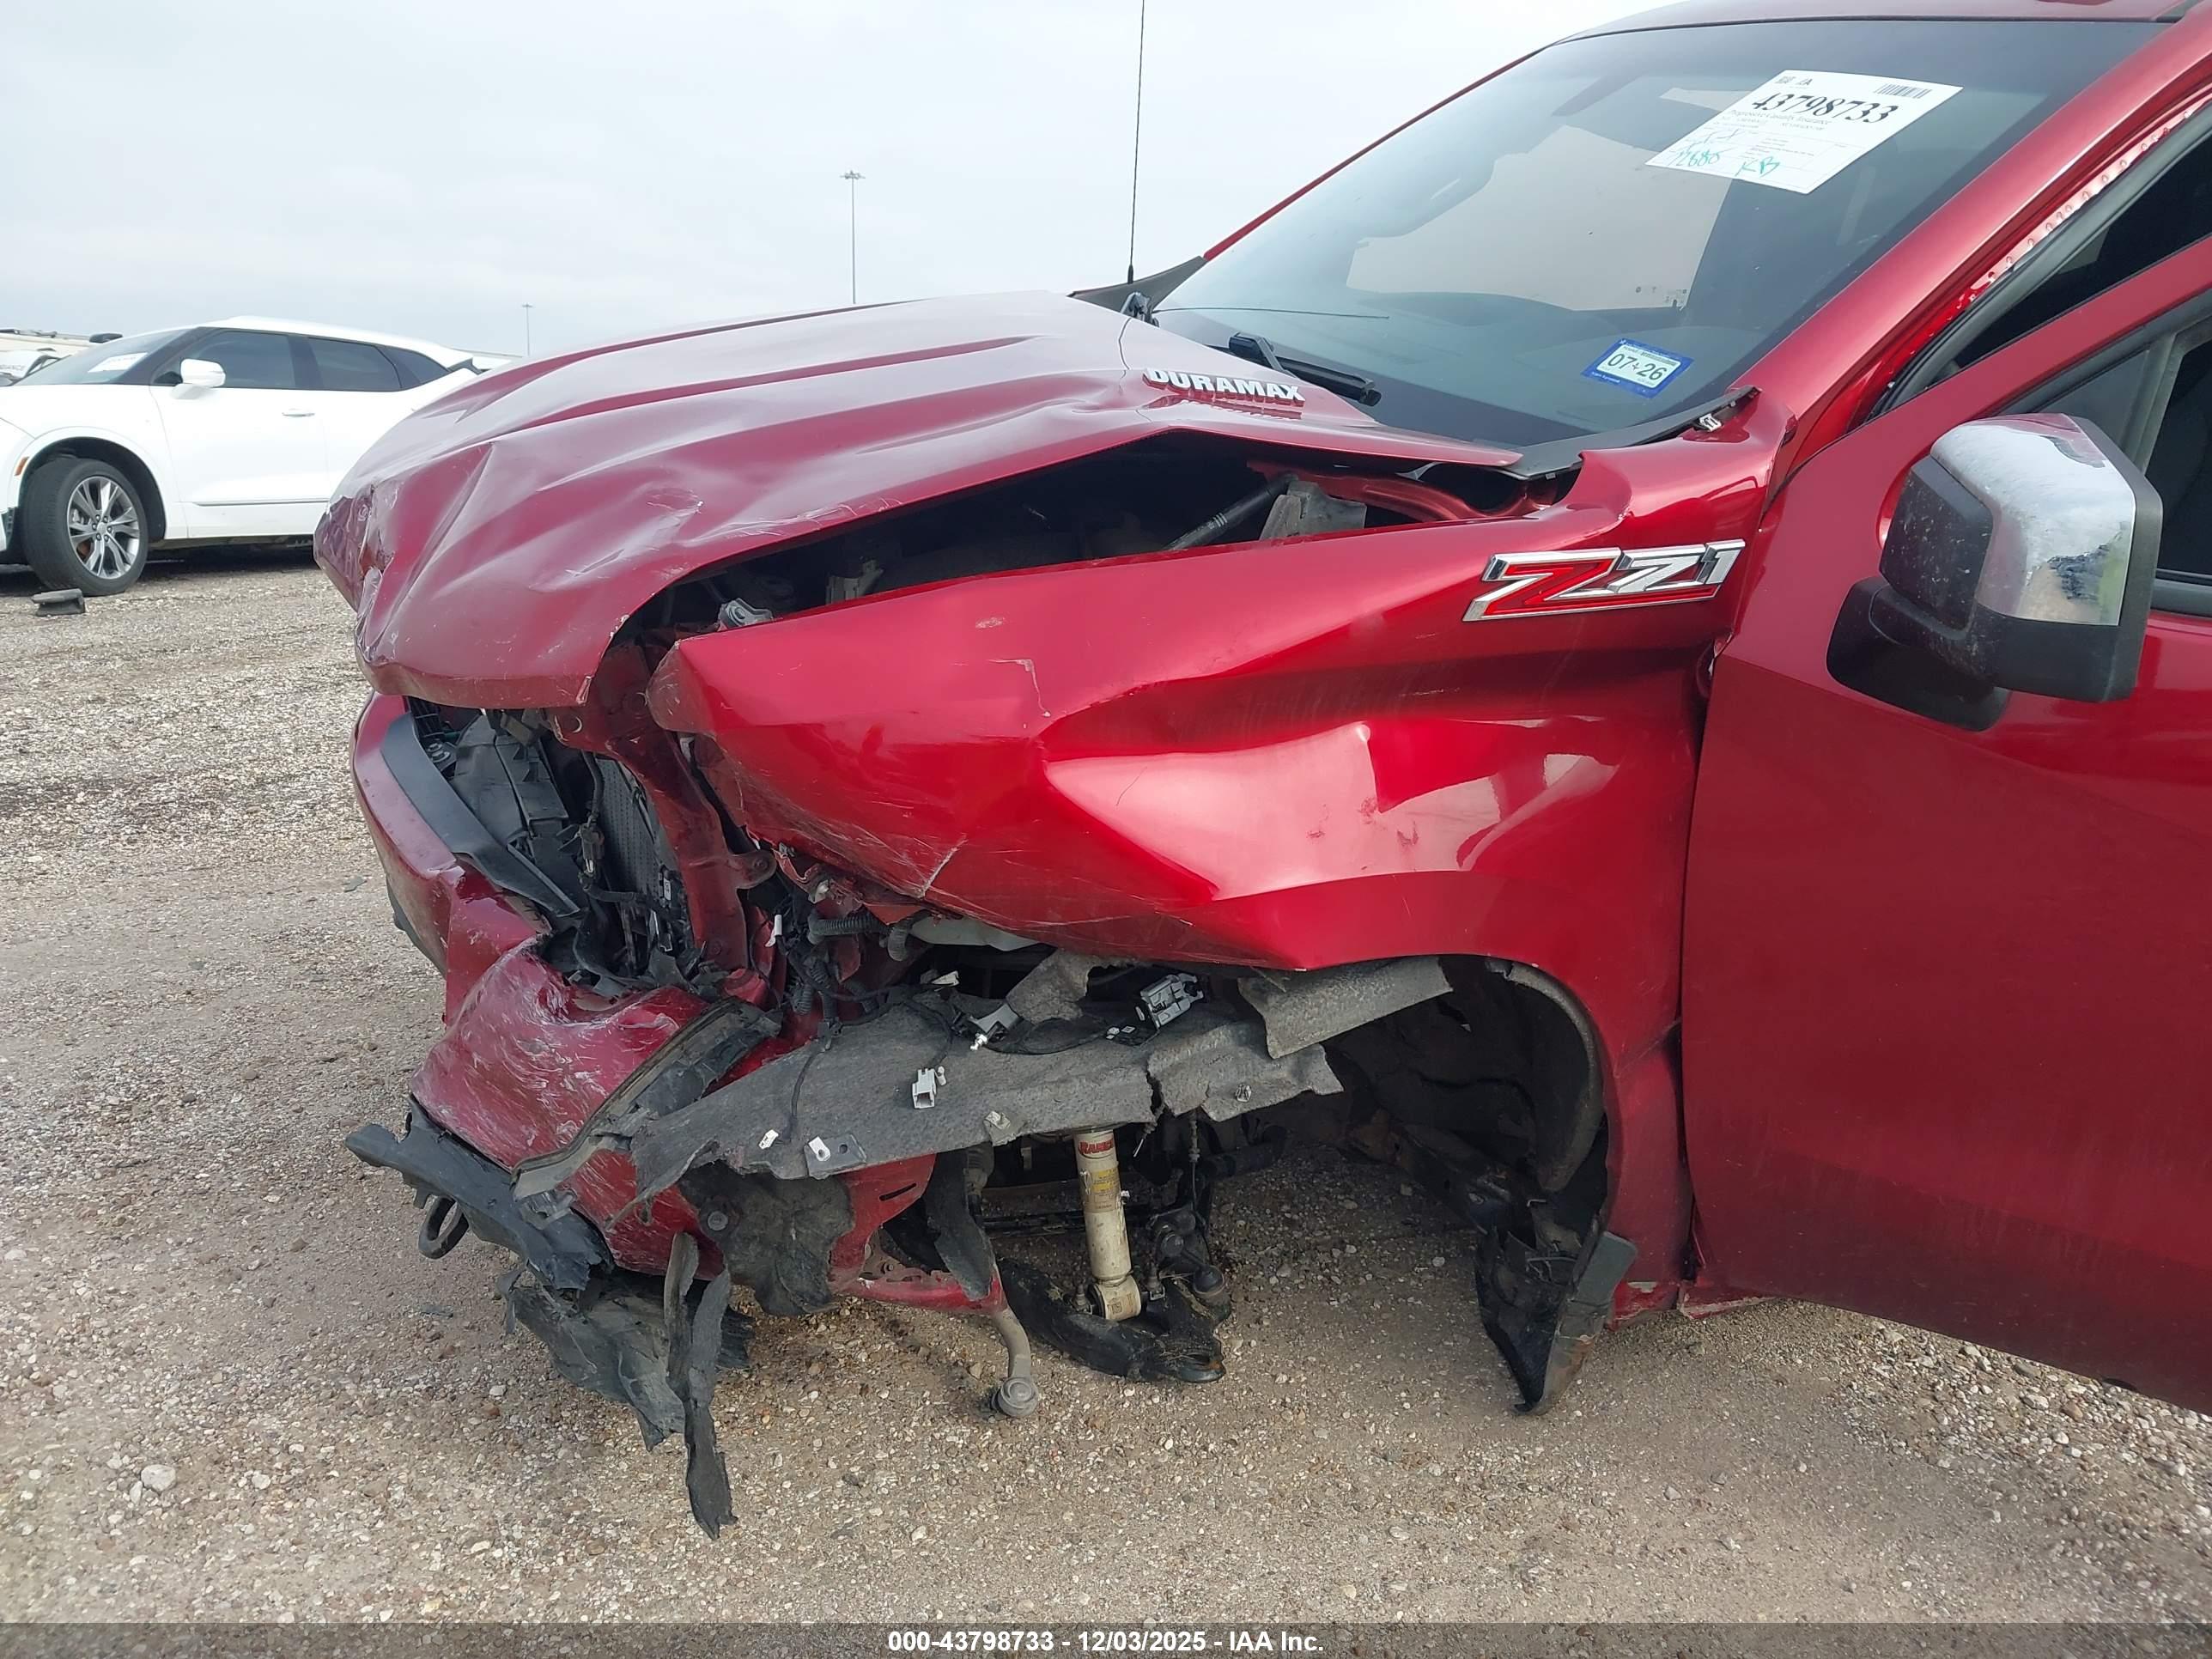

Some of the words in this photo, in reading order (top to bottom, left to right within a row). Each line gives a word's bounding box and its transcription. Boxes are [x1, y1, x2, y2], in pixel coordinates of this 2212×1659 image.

[1752, 92, 1899, 124] 43798733
[1143, 368, 1305, 404] DURAMAX
[1462, 538, 1746, 622] Z71
